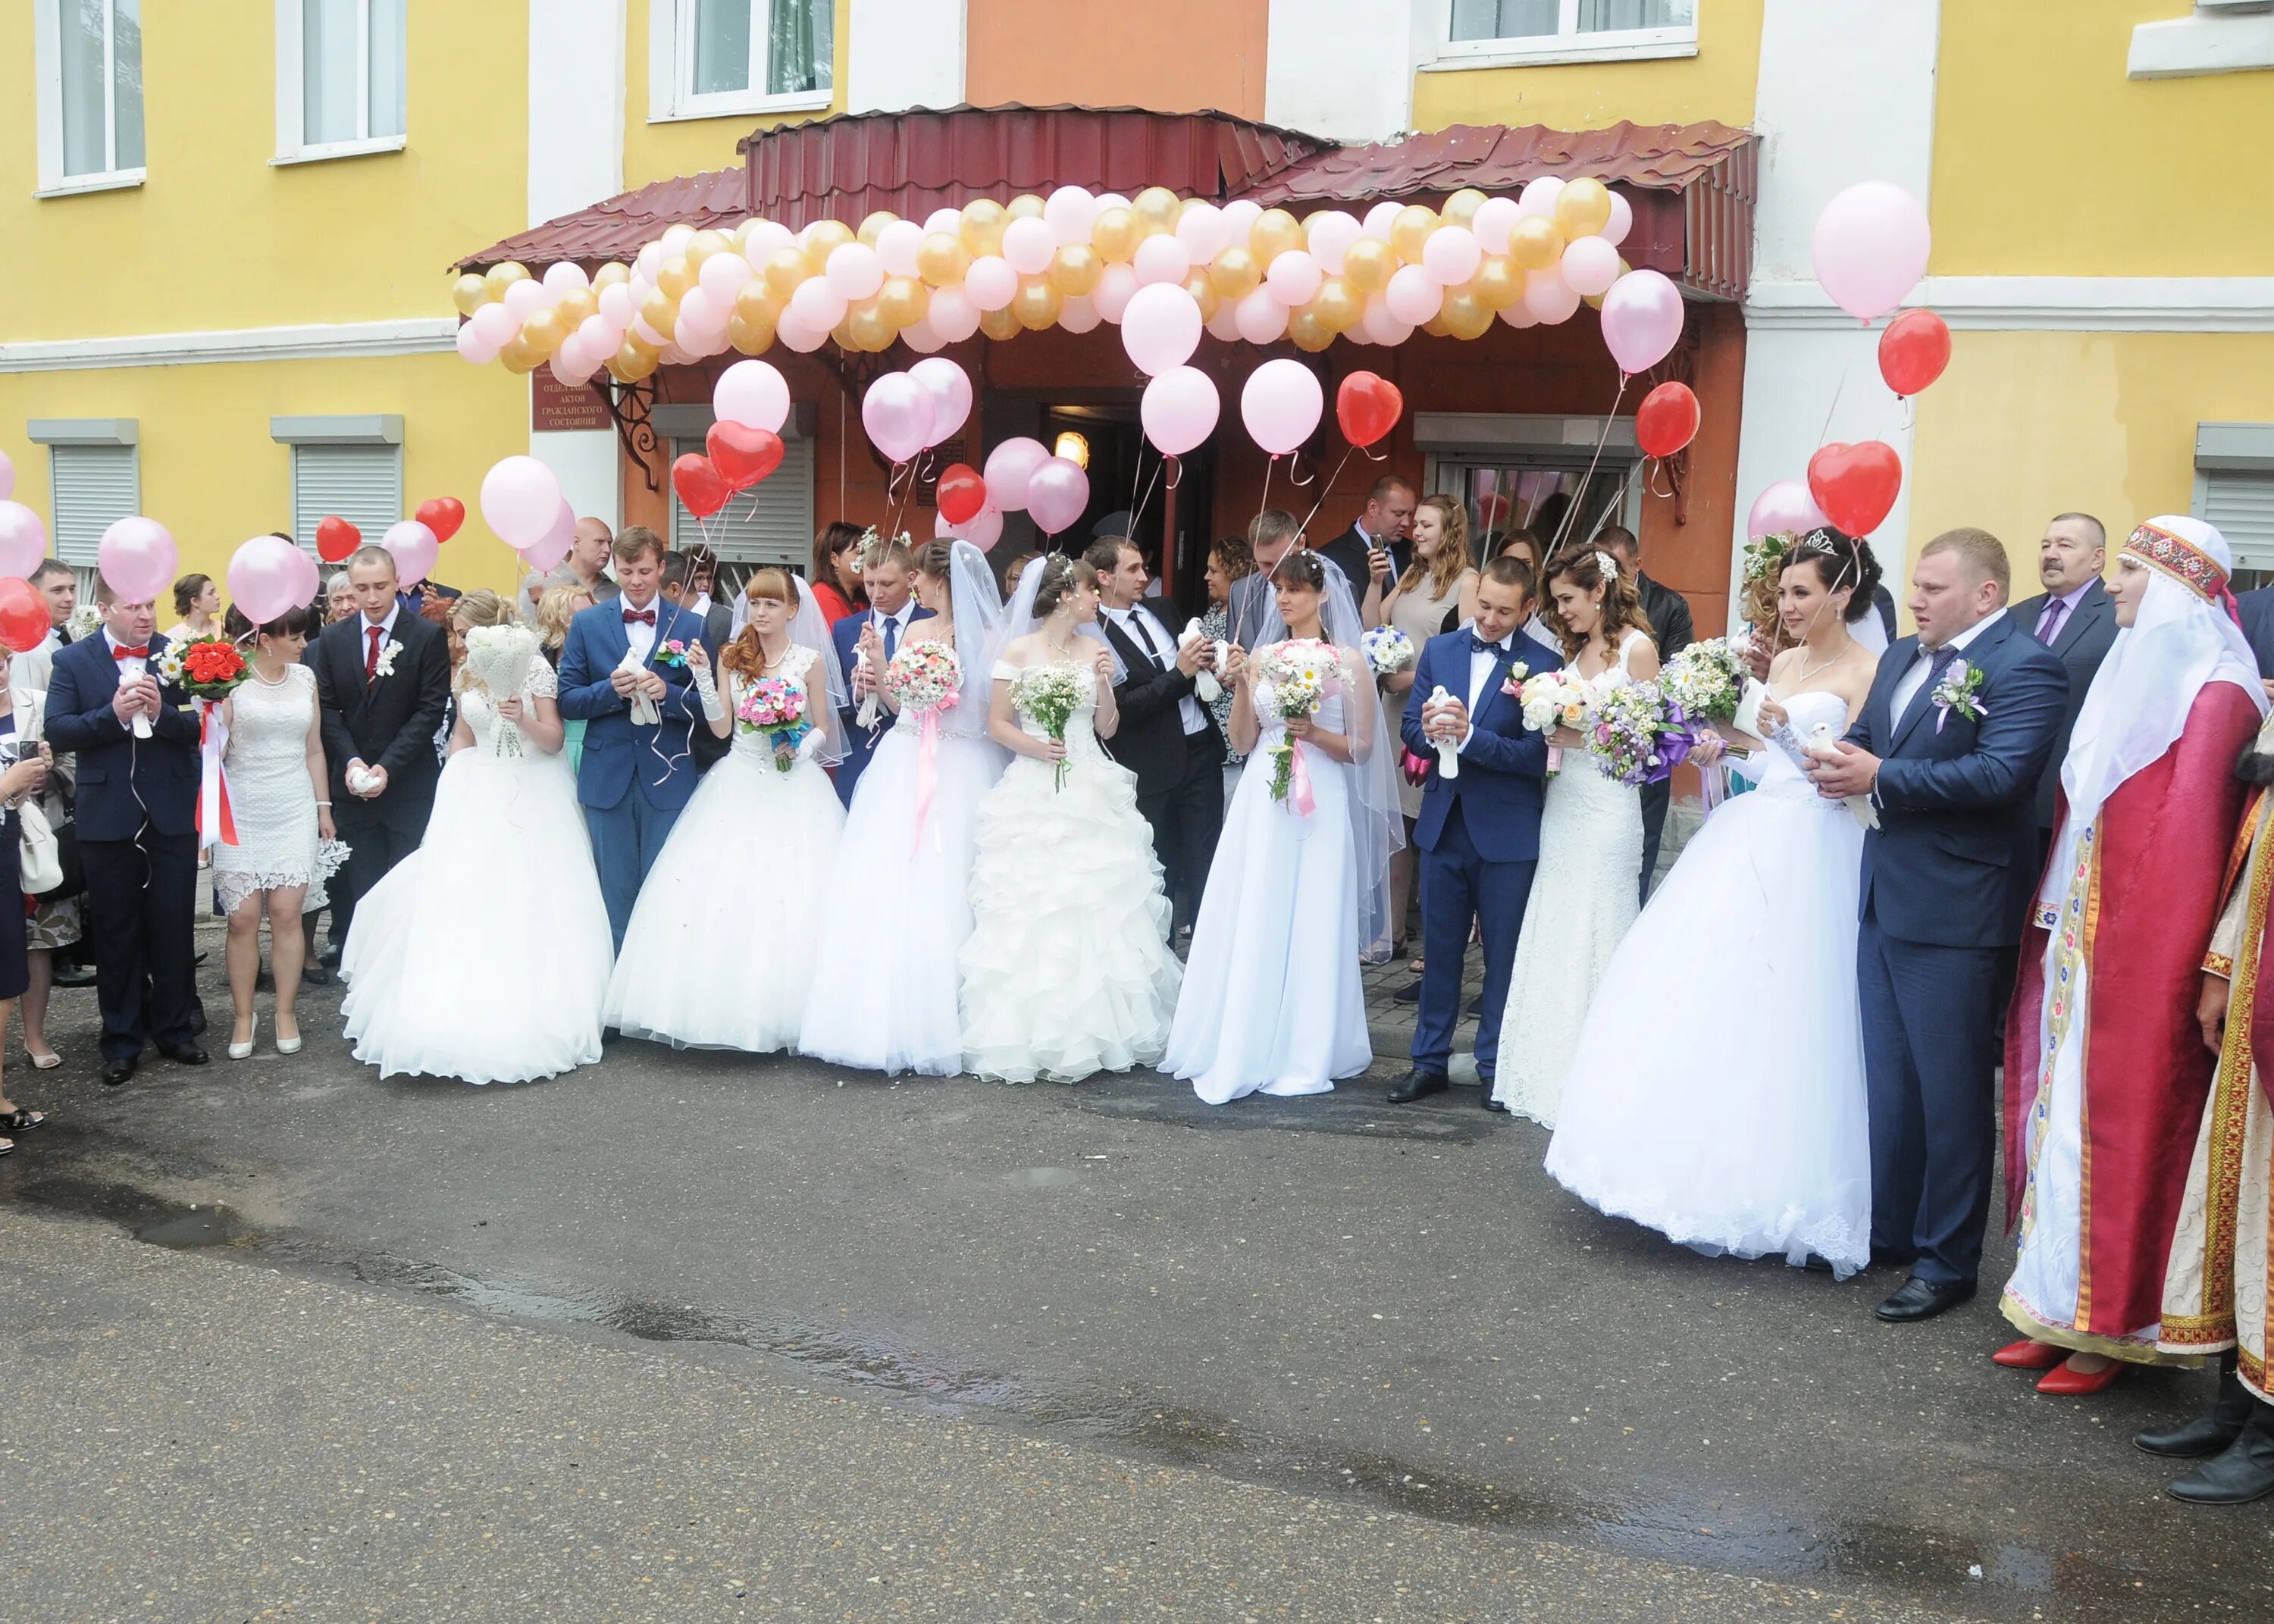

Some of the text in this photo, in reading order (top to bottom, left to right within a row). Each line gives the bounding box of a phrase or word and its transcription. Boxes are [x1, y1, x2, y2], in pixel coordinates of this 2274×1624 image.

[543, 384, 568, 393] ОТДЕЛ
[561, 395, 585, 403] АКТОВ
[542, 406, 603, 415] ГРАЖДАНСКОГО
[550, 418, 596, 426] СОСТОЯНИЯ
